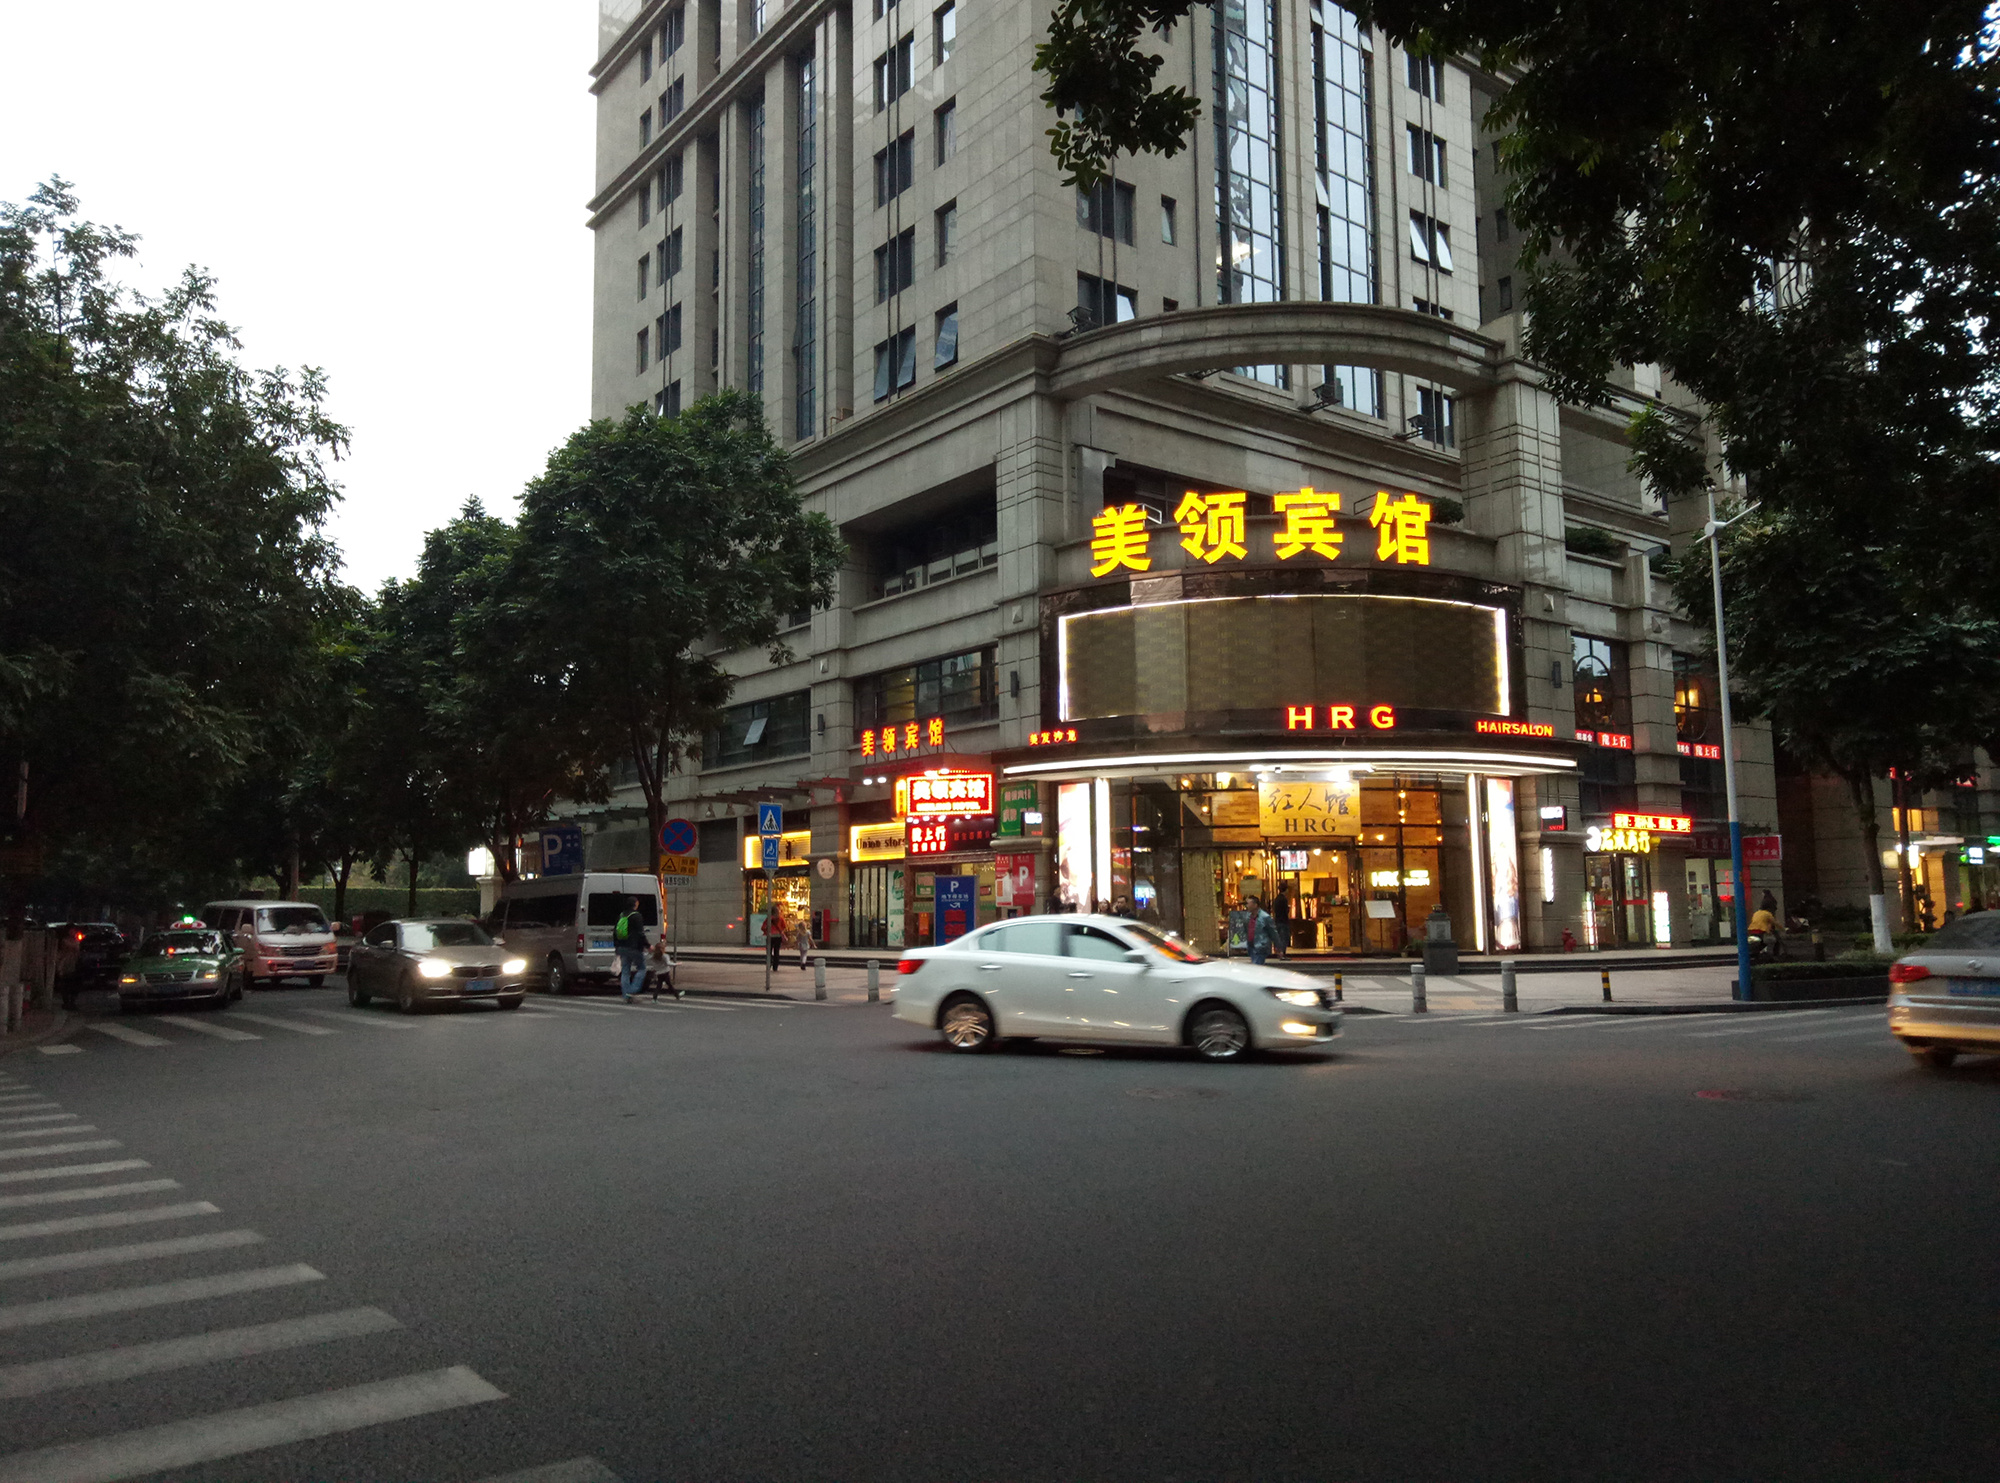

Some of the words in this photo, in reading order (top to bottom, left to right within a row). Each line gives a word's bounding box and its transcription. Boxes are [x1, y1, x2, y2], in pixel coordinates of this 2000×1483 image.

[1089, 487, 1432, 578] 美领宾馆
[1286, 705, 1395, 730] HRG
[1476, 720, 1553, 738] HAIRSALON
[861, 717, 944, 757] 美领宾馆
[1029, 729, 1078, 746] 美发沙龙
[912, 778, 986, 801] 美领宾馆
[1267, 787, 1352, 816] 红人馆
[1285, 817, 1337, 833] HRG
[542, 834, 563, 869] P
[856, 837, 881, 850] Union
[950, 880, 960, 893] P
